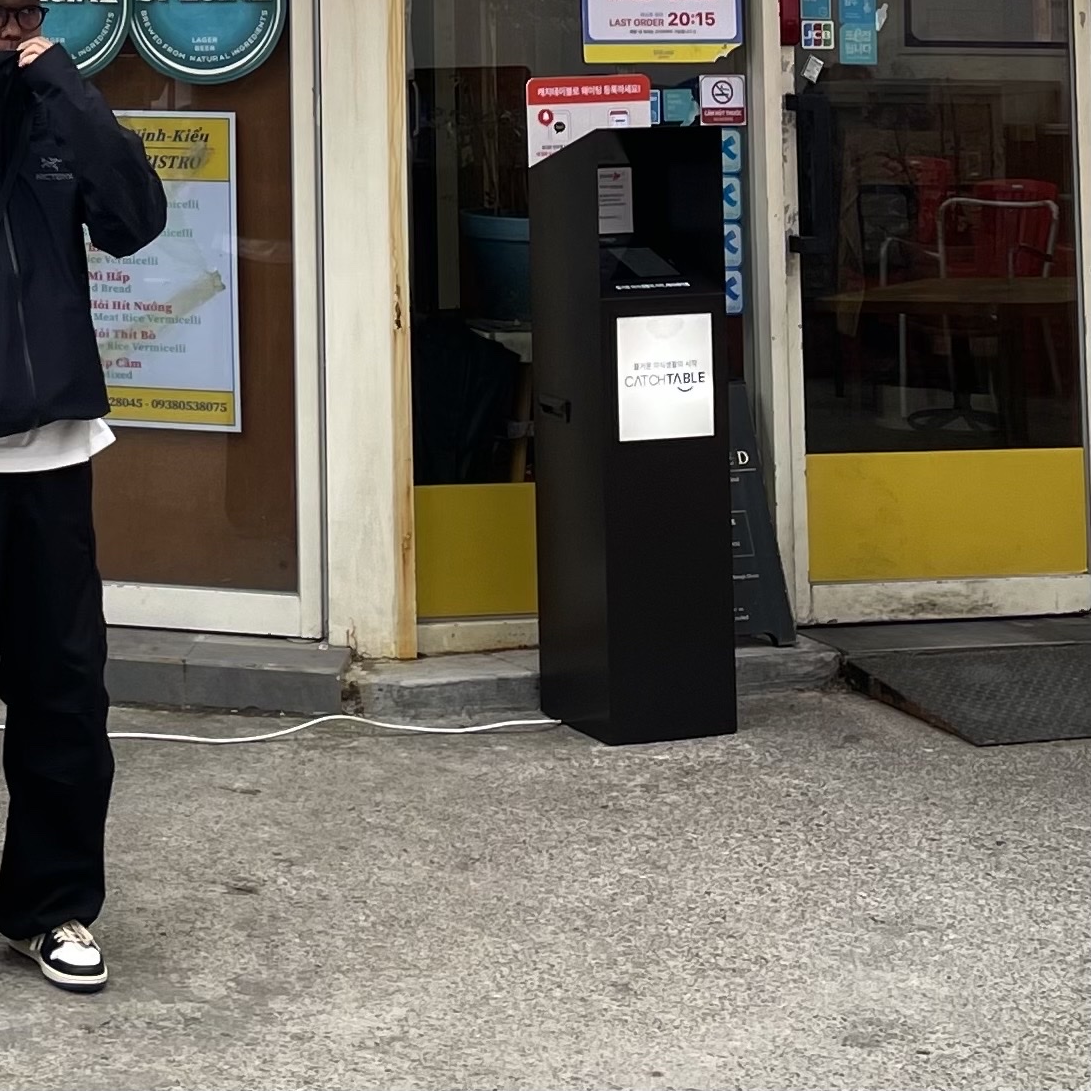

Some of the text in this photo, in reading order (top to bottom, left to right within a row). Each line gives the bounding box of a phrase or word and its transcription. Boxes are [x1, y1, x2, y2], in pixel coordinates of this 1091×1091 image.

[609, 19, 631, 27] LAST
[634, 19, 664, 27] ORDER
[667, 12, 715, 27] 20:15
[78, 12, 115, 56] INGREDIENTS
[141, 10, 268, 62] BREWED FROM NATURAL INGREDIENTS
[101, 284, 131, 293] Bread
[94, 313, 201, 325] Meat Rice Vermicelli
[108, 342, 129, 351] Rice
[132, 343, 186, 353] Vermicelli
[625, 371, 705, 388] CATCHTABLE
[152, 399, 227, 413] 09380538075
